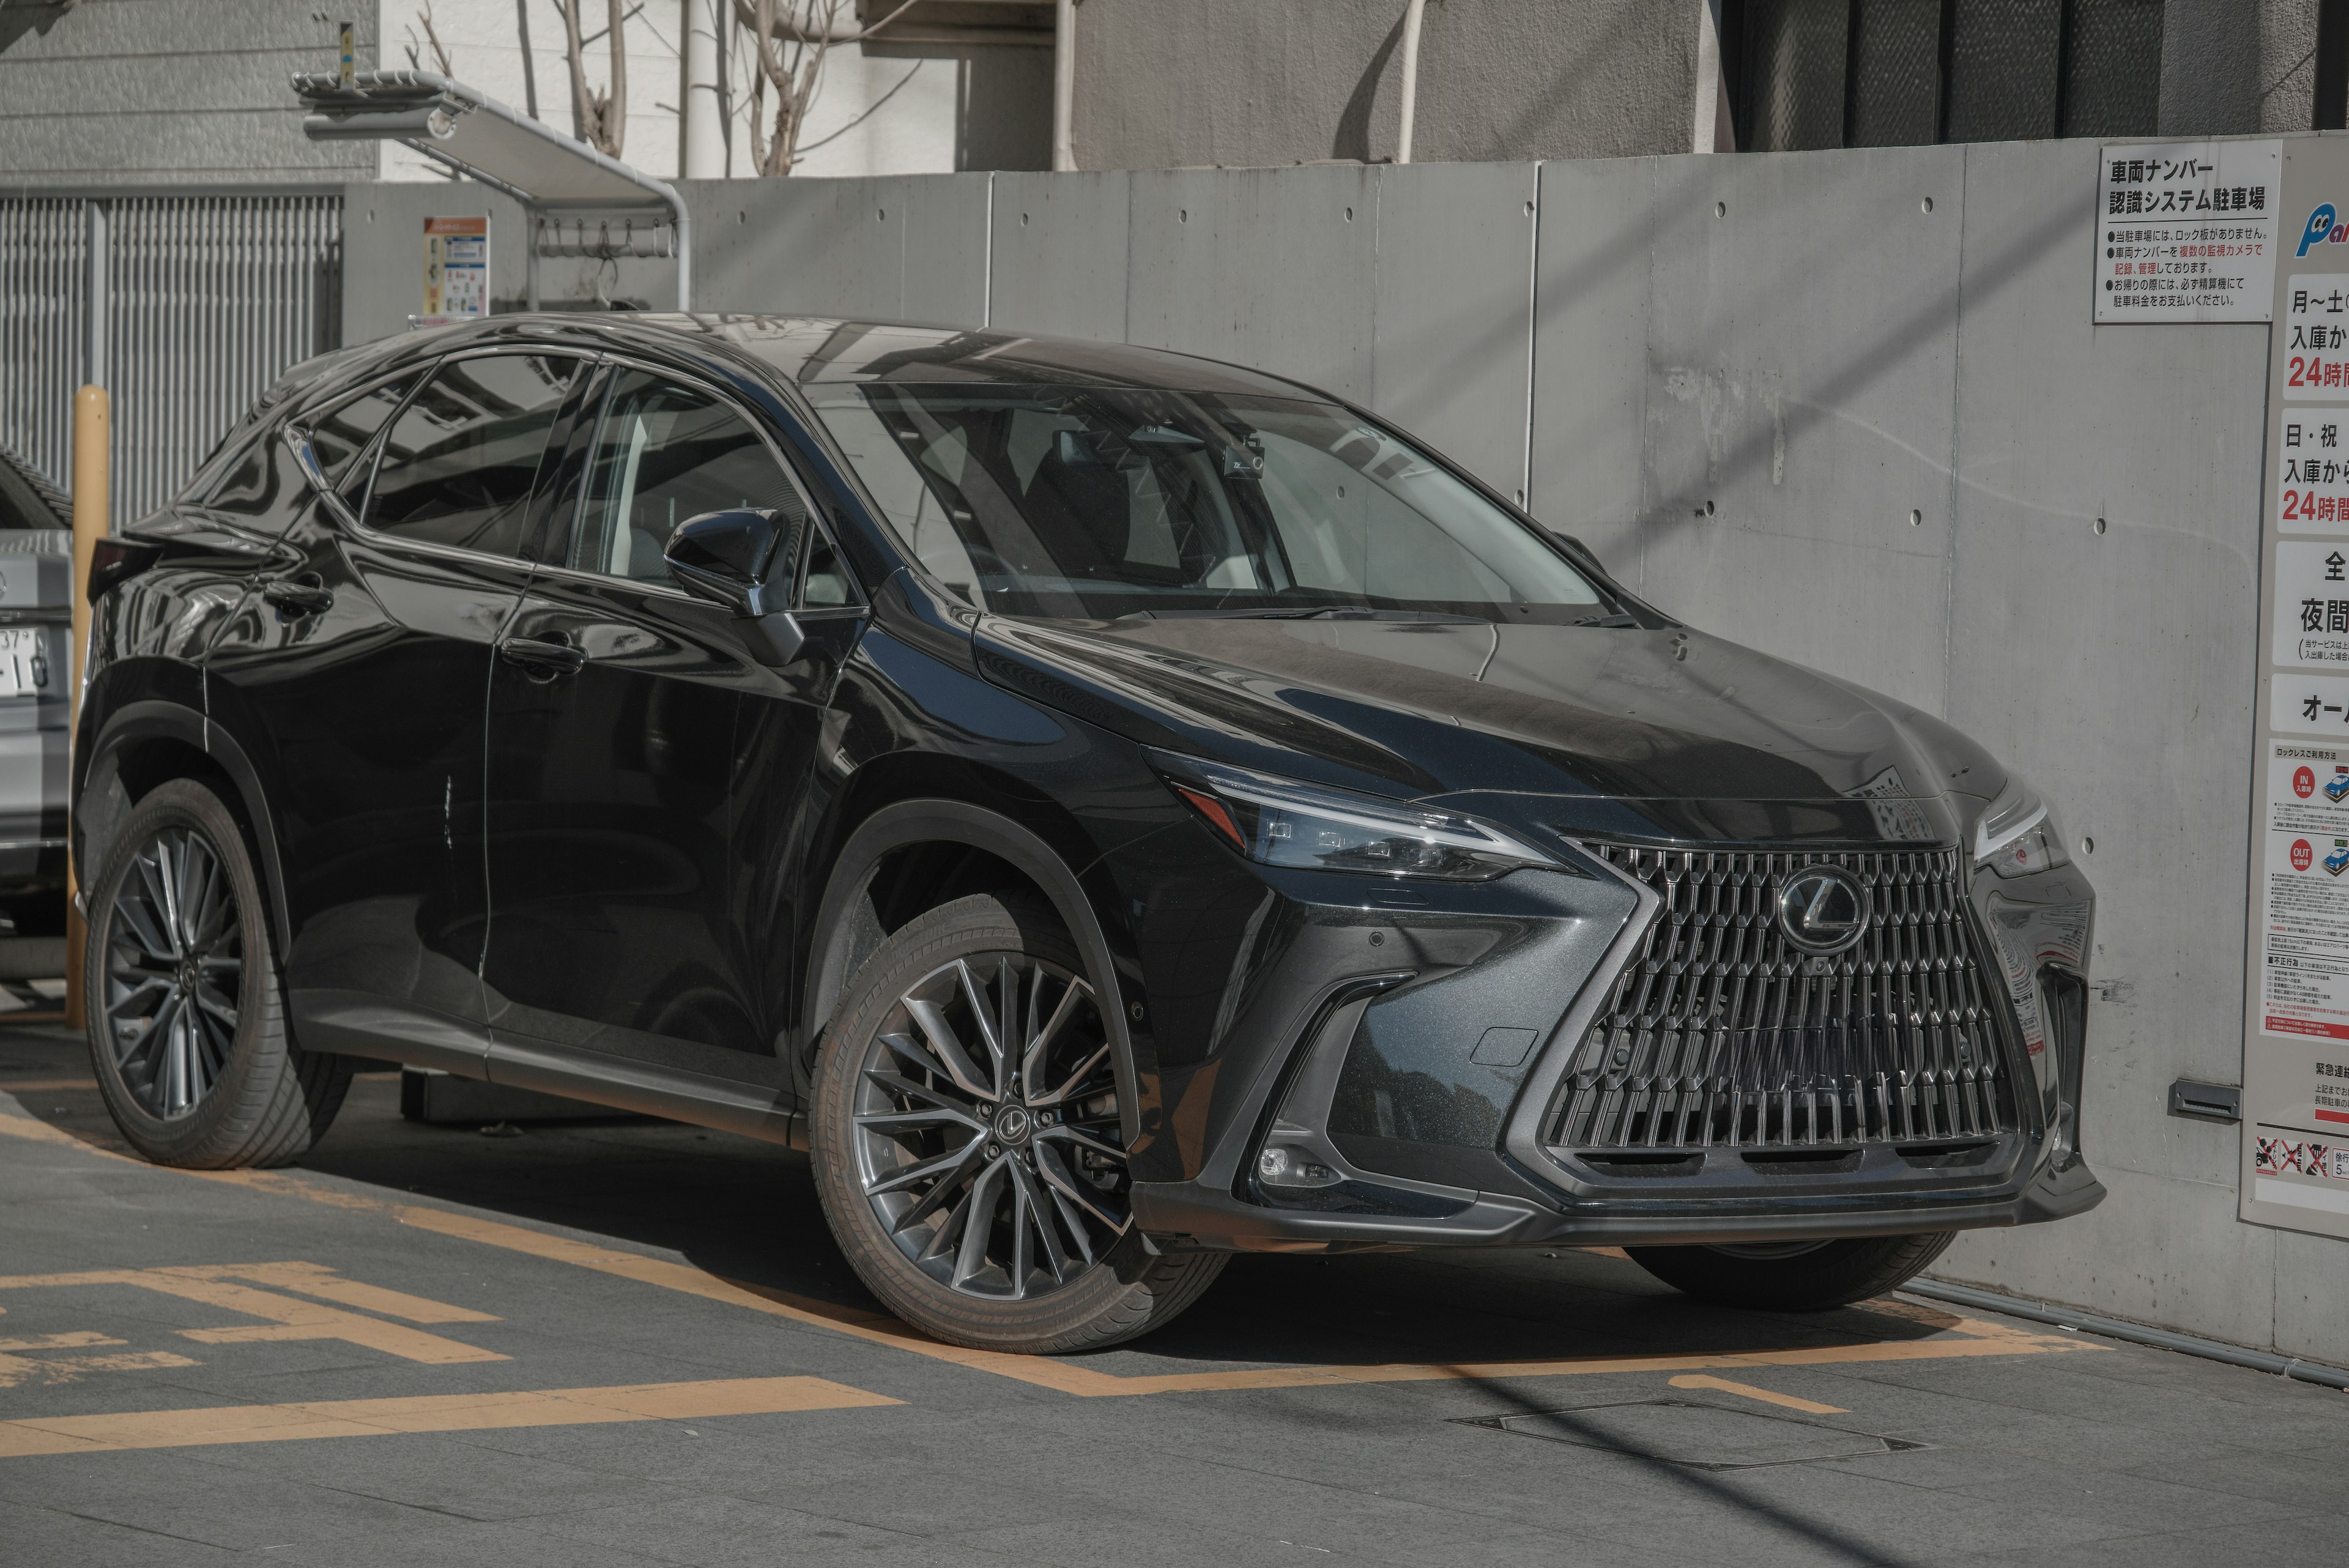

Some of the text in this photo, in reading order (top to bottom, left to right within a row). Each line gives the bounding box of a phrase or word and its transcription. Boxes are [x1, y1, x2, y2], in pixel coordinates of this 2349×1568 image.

[2110, 158, 2213, 184] 車両ナンバー
[2109, 186, 2265, 214] 認識システム駐車場
[2115, 262, 2212, 275] 記録、管理しております。
[2114, 278, 2244, 291] お帰りの際には、必ず精算機にて
[2113, 294, 2233, 307] 駐車料金をお支払いください。
[2290, 325, 2347, 350] 入庫か
[2287, 424, 2337, 447] 日・祝
[2325, 551, 2347, 581] 全
[2301, 598, 2349, 633] 夜間
[2305, 639, 2349, 650] 当サービスは上
[2305, 650, 2349, 661] 入出庫した場合
[2277, 748, 2336, 760] ロックレスご利用方法
[2300, 775, 2309, 784] IN
[2293, 847, 2310, 858] OUT
[2315, 1084, 2349, 1096] 上記までお
[2315, 1096, 2349, 1108] 長期駐車の
